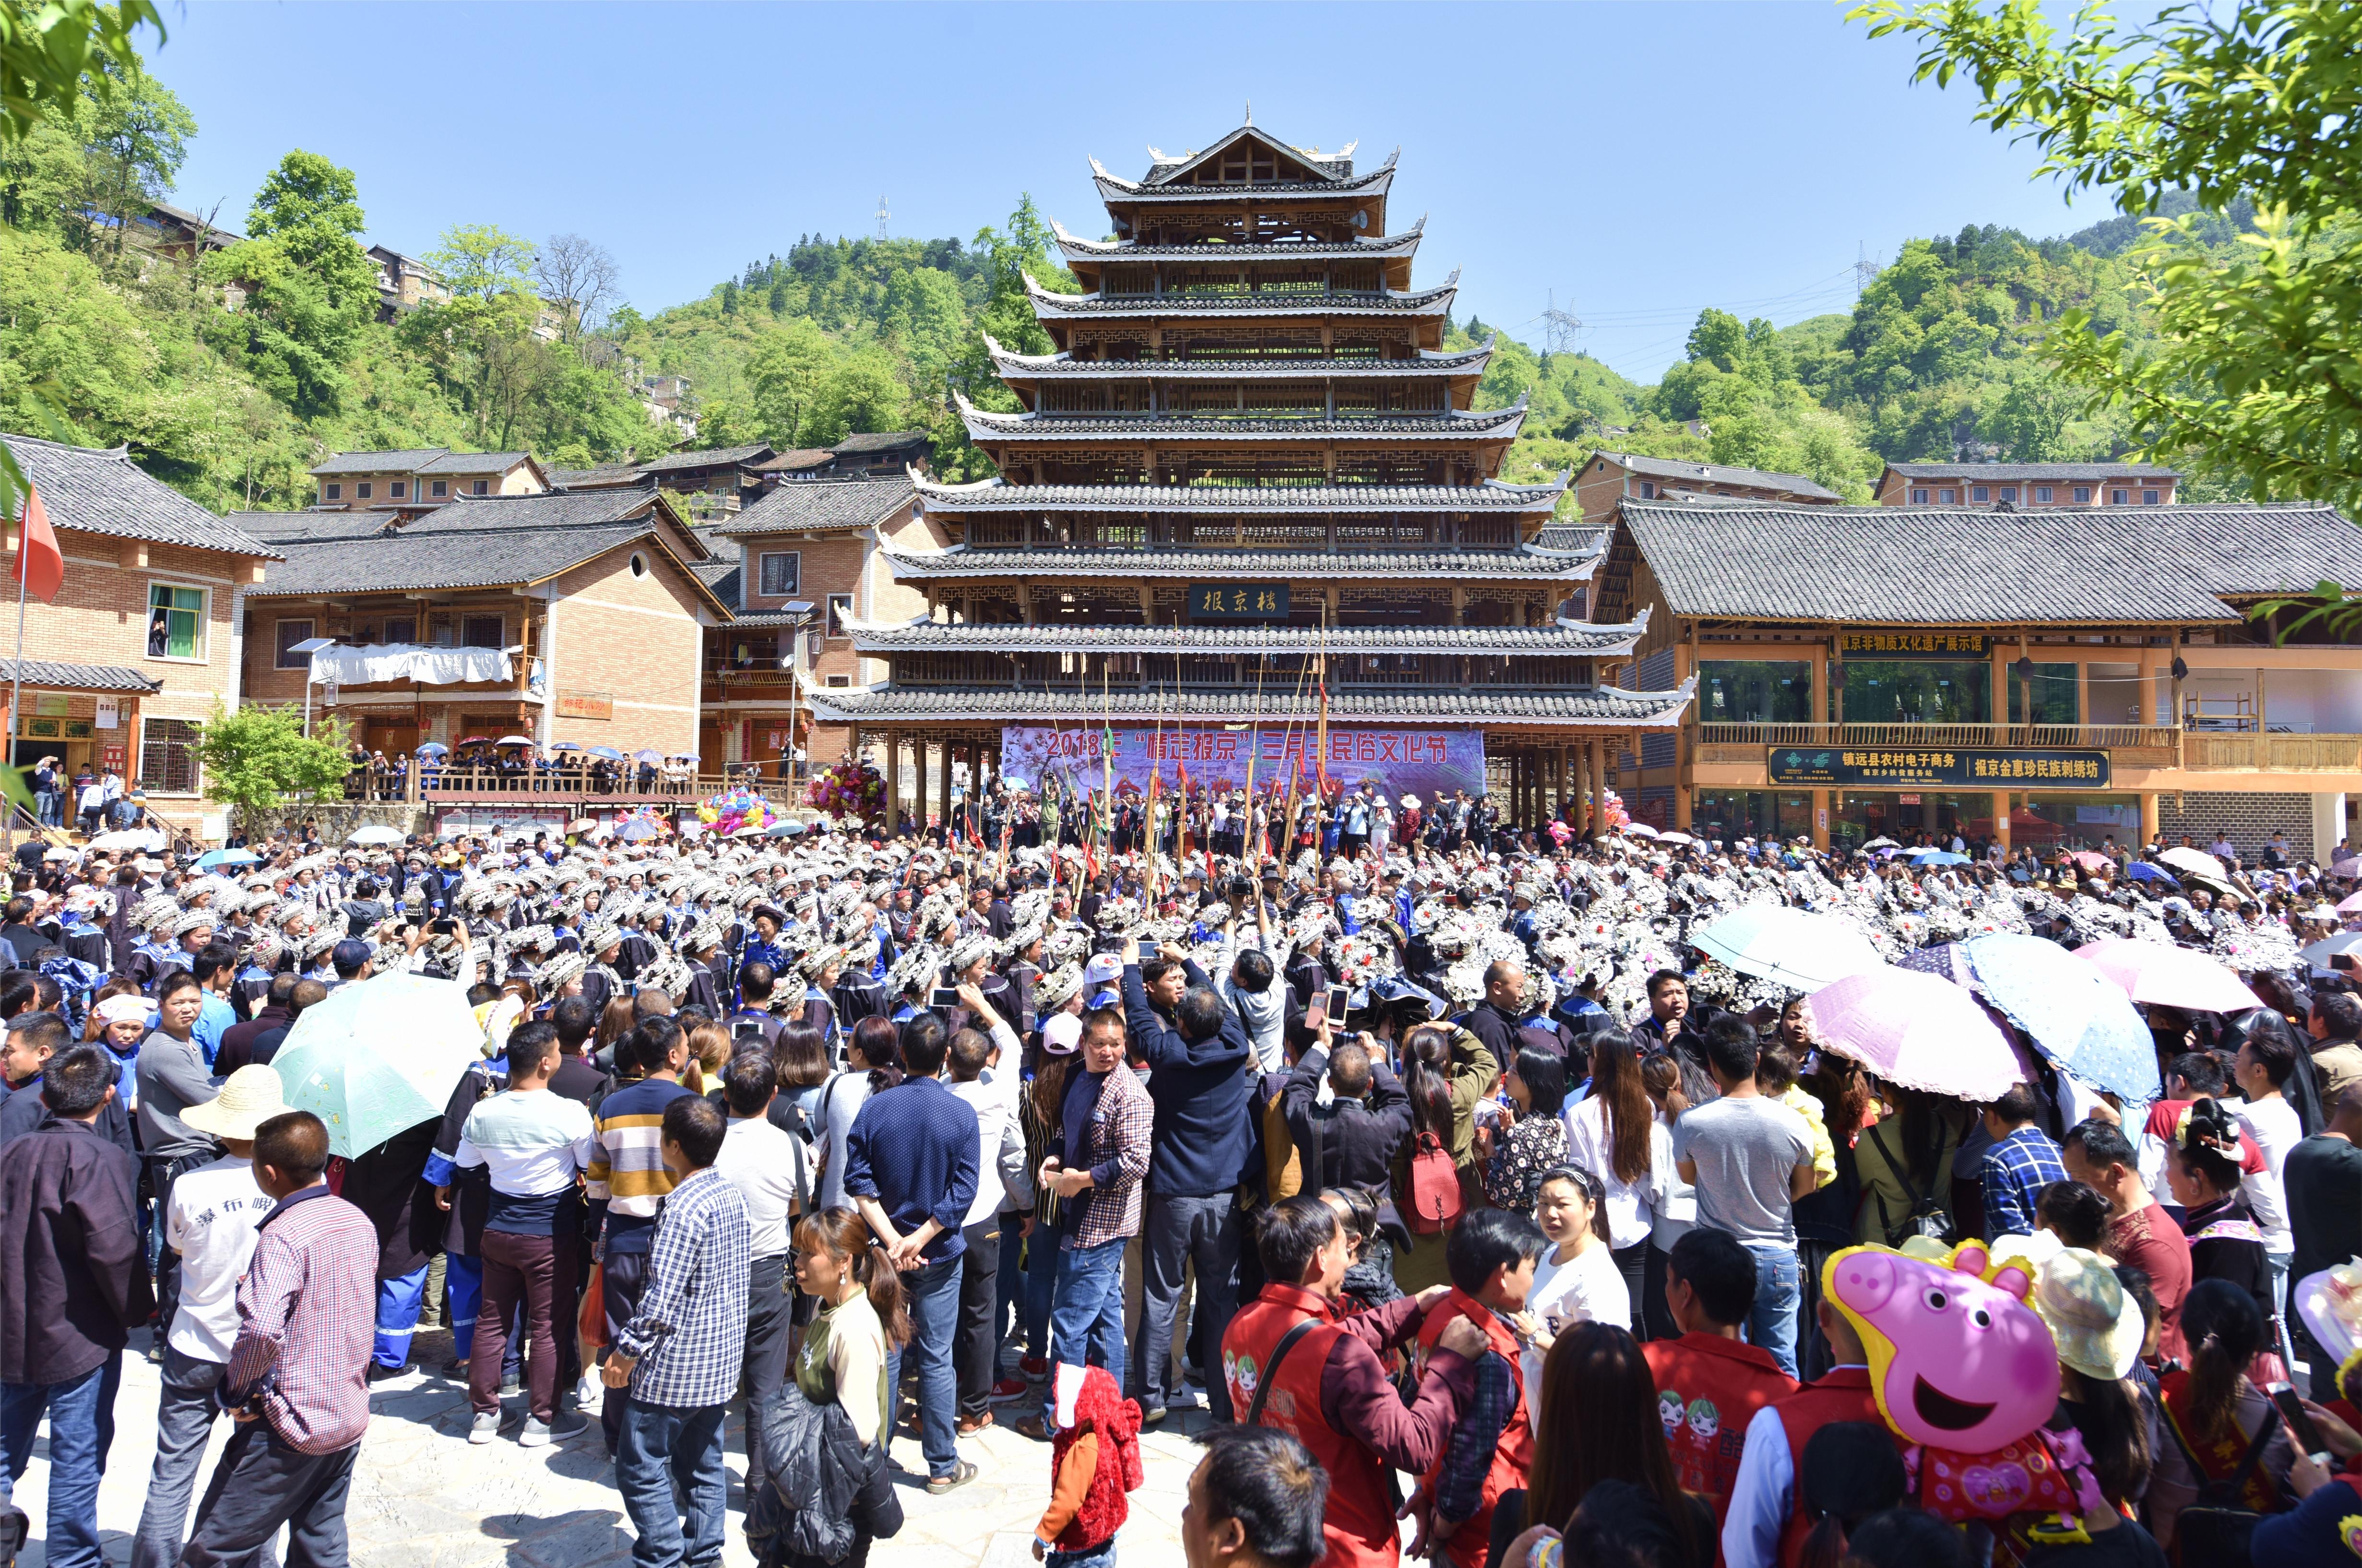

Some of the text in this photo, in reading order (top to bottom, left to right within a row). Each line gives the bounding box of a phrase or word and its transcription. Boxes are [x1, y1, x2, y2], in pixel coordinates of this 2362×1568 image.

[1202, 589, 1276, 612] 报京楼
[1842, 752, 1956, 768] 镇远县农村电子商务
[1975, 759, 2099, 778] 报京金惠珍民族刺绣坊
[1863, 769, 1933, 777] 报京乡扶贫服务站
